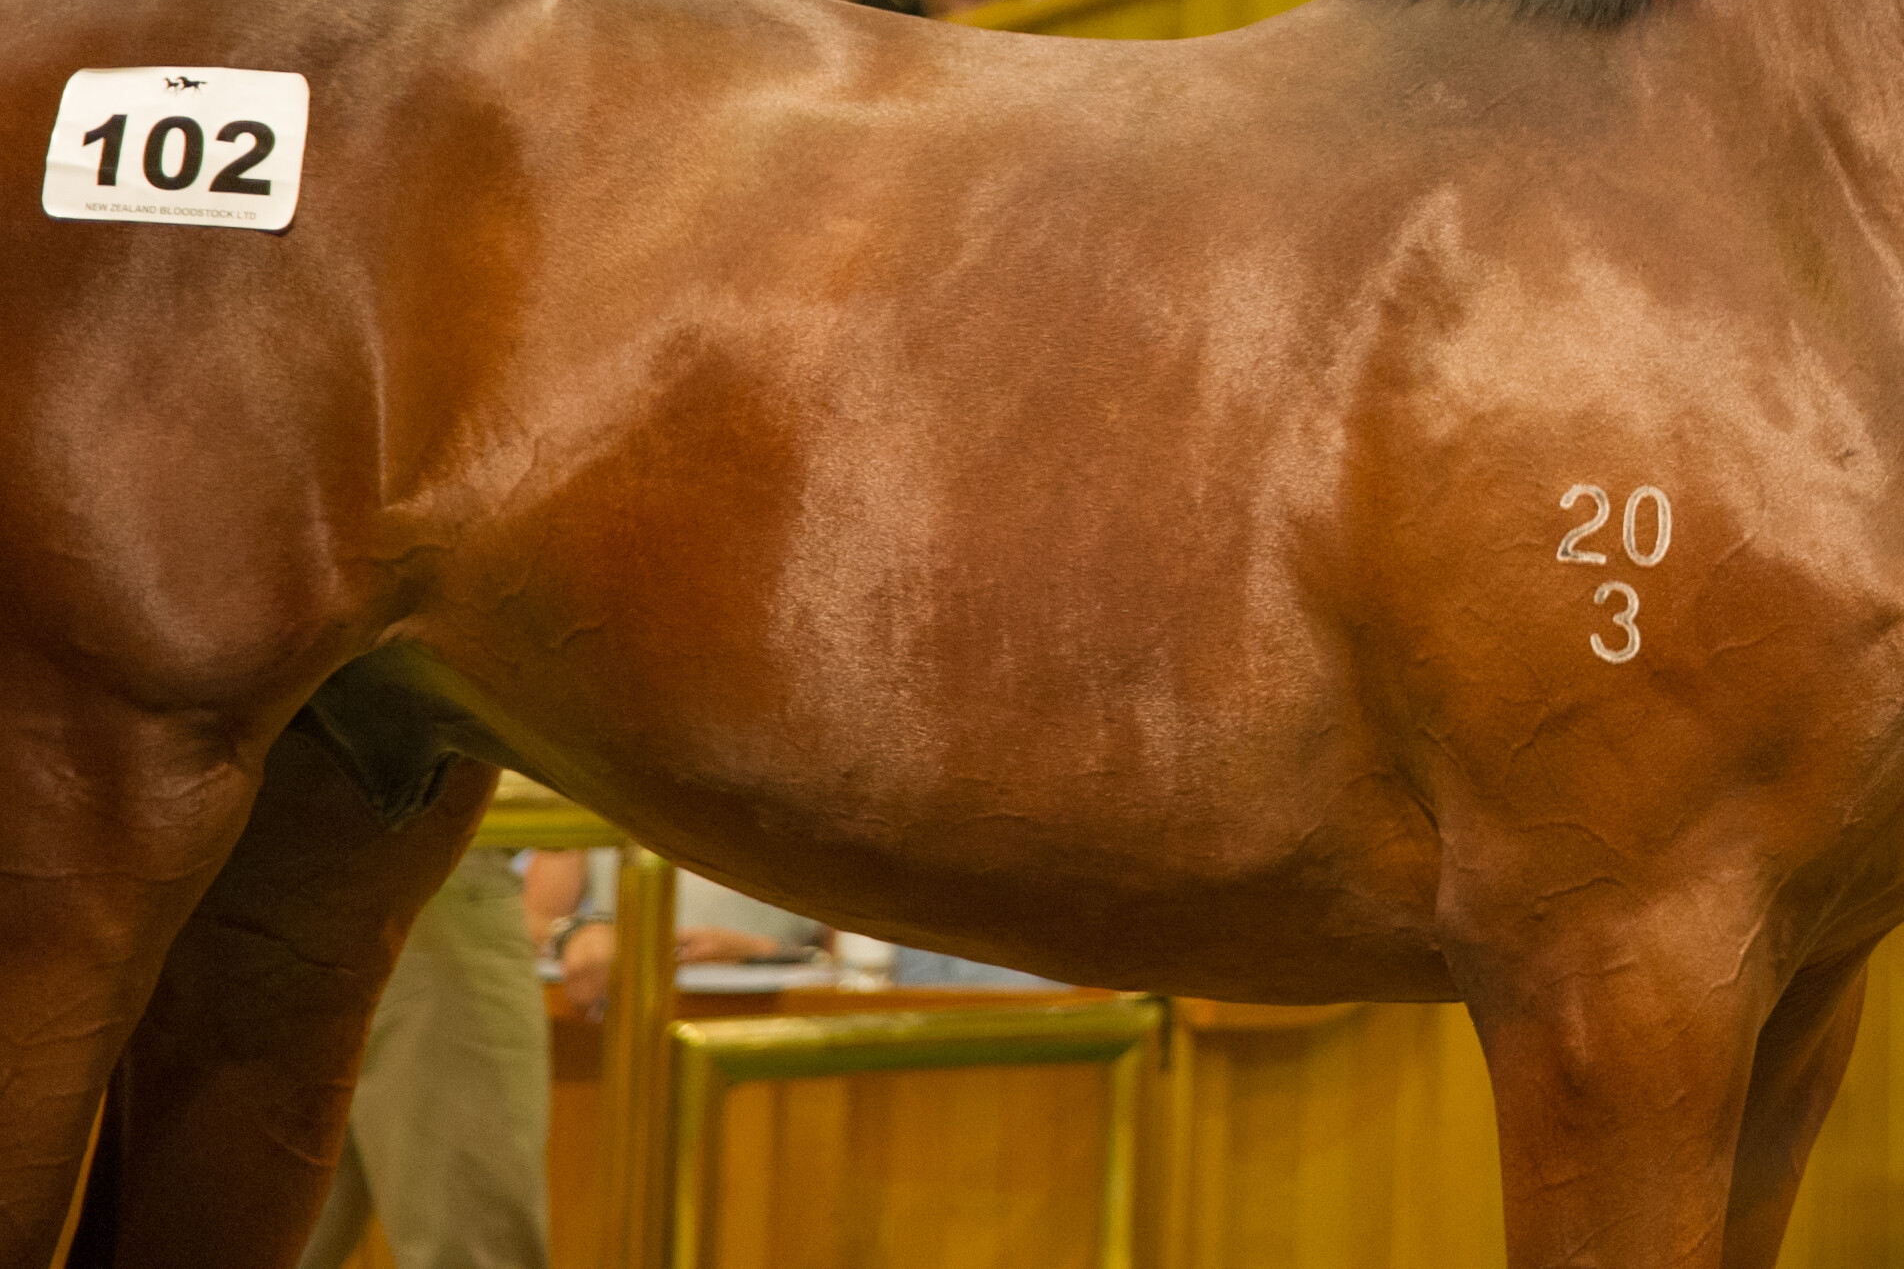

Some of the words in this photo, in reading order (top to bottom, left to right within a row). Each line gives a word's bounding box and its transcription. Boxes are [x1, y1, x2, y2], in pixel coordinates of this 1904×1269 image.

[81, 113, 276, 196] 102
[85, 202, 108, 212] NEW
[109, 203, 157, 215] ZEALAND
[159, 206, 233, 219] BLOODSTOCK
[236, 210, 257, 221] LTD
[1556, 483, 1672, 567] 20
[1589, 581, 1641, 664] 3
